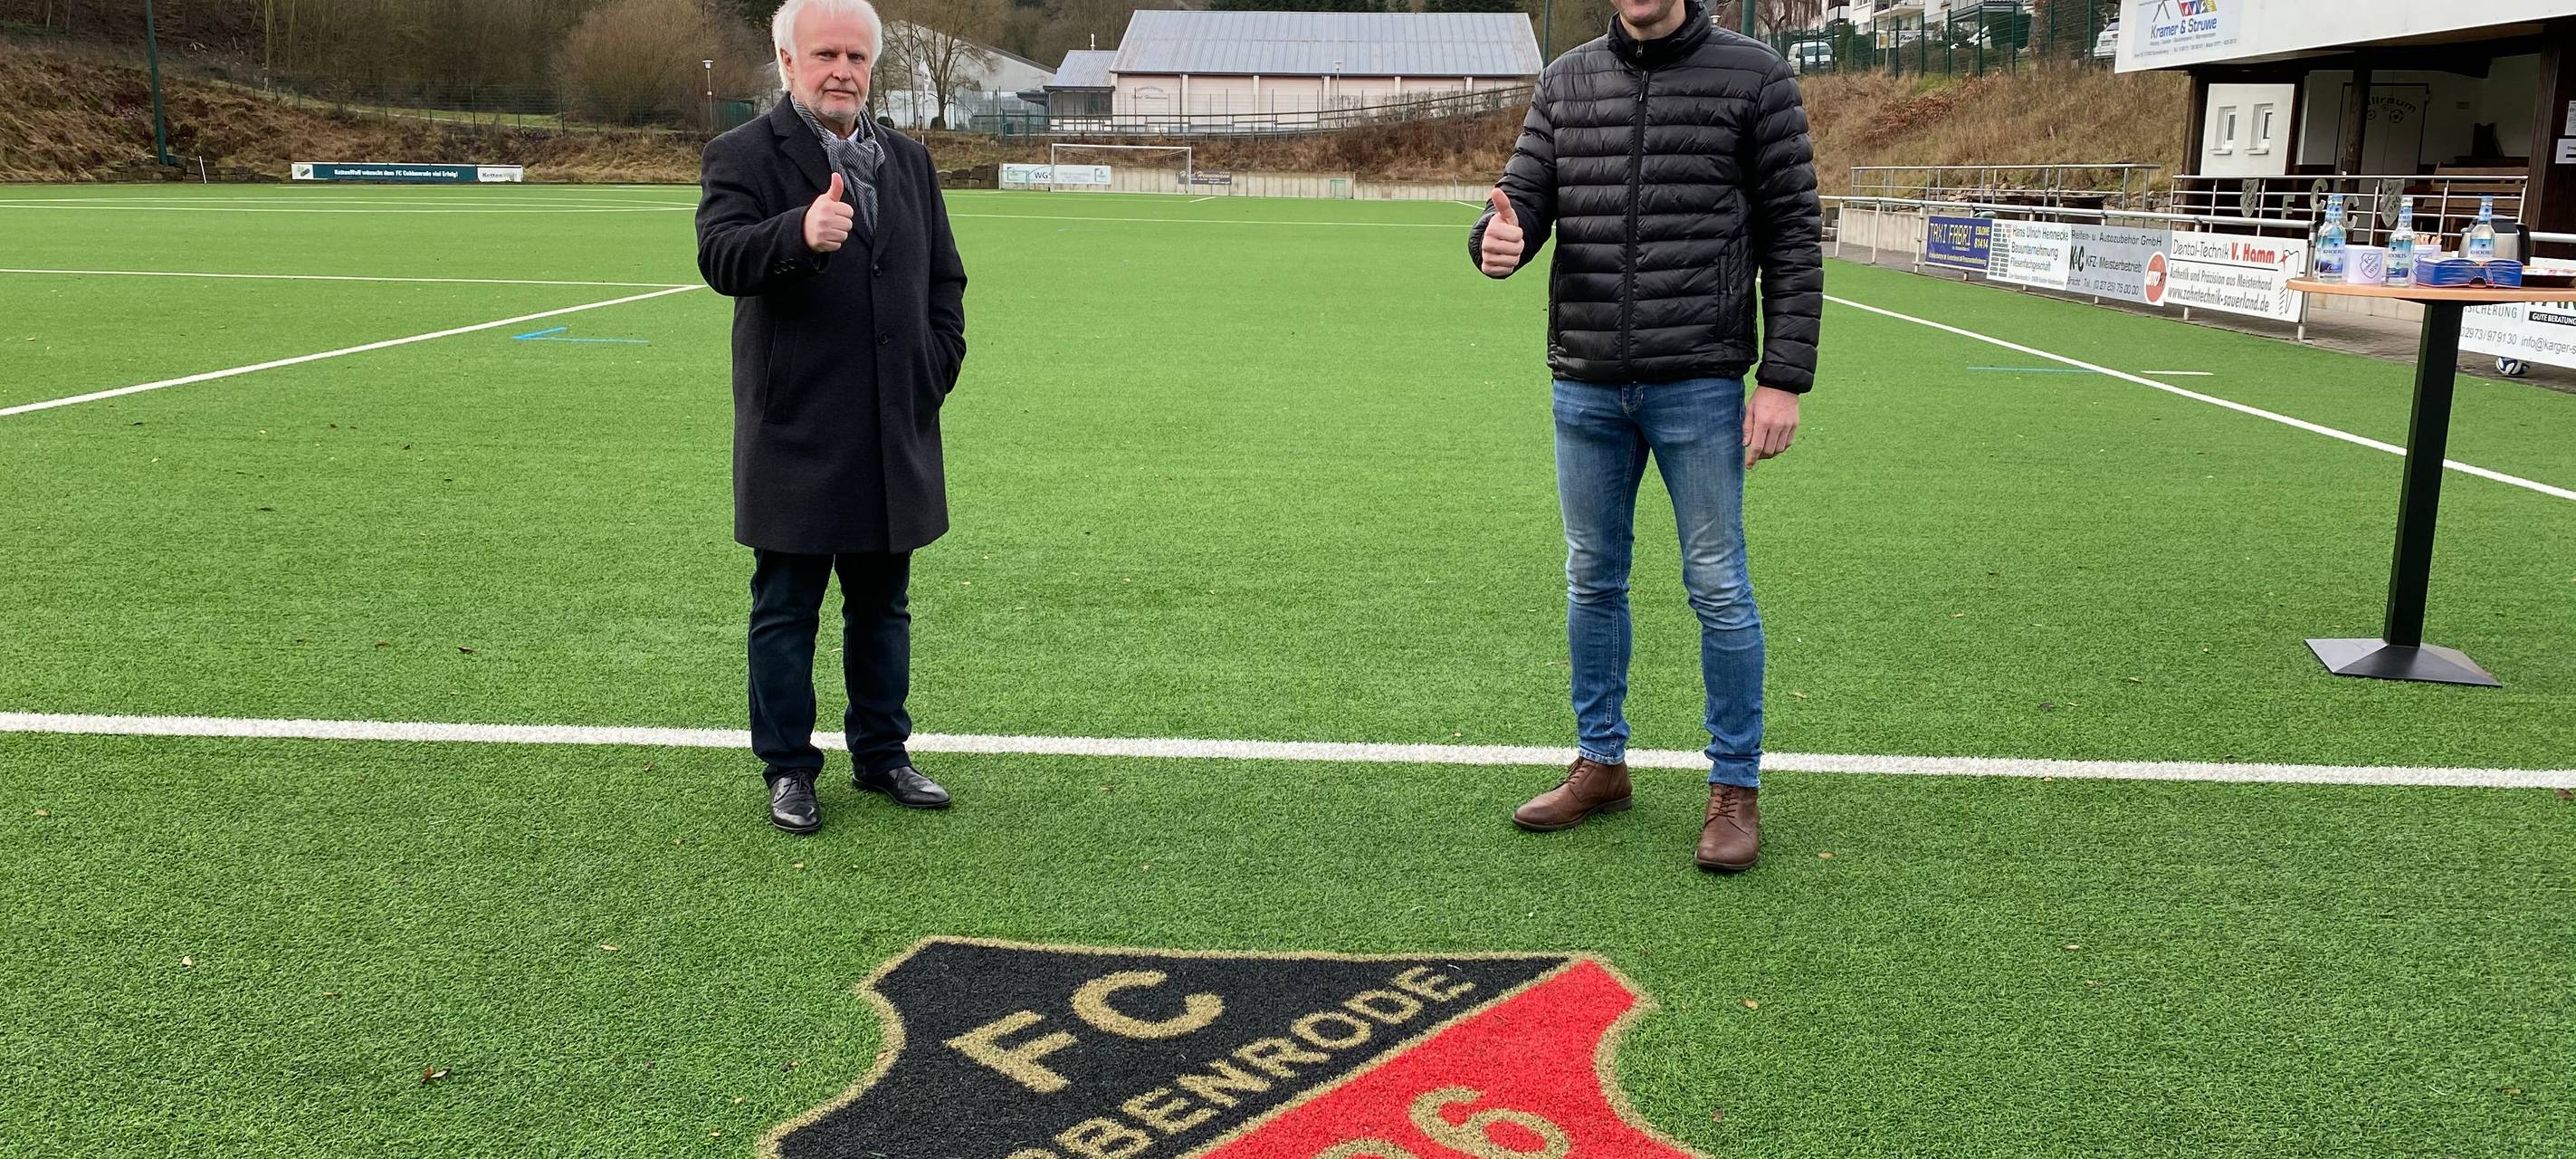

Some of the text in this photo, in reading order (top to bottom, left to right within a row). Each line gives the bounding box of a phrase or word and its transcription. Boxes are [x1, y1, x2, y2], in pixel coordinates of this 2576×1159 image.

[2151, 17, 2218, 39] Kramer & Struwe
[1930, 223, 1972, 246] TAXI FABRI
[2012, 225, 2069, 241] Hans Ulrich Hennecke
[2140, 235, 2162, 247] GmbH
[2011, 241, 2059, 261] Bauunternehmung
[2172, 239, 2275, 264] Dental-Technik V. Hamm
[2170, 263, 2273, 292] Ästhetik und Präzision aus Meisterhand
[2167, 285, 2270, 312] www.zahntechnik-sauerland.de
[2464, 304, 2518, 319] SICHERUNG
[2532, 312, 2548, 322] GUTE
[941, 969, 1226, 1093] FC
[1005, 964, 1477, 1159] BENRODE
[1310, 1085, 1572, 1159] 6
